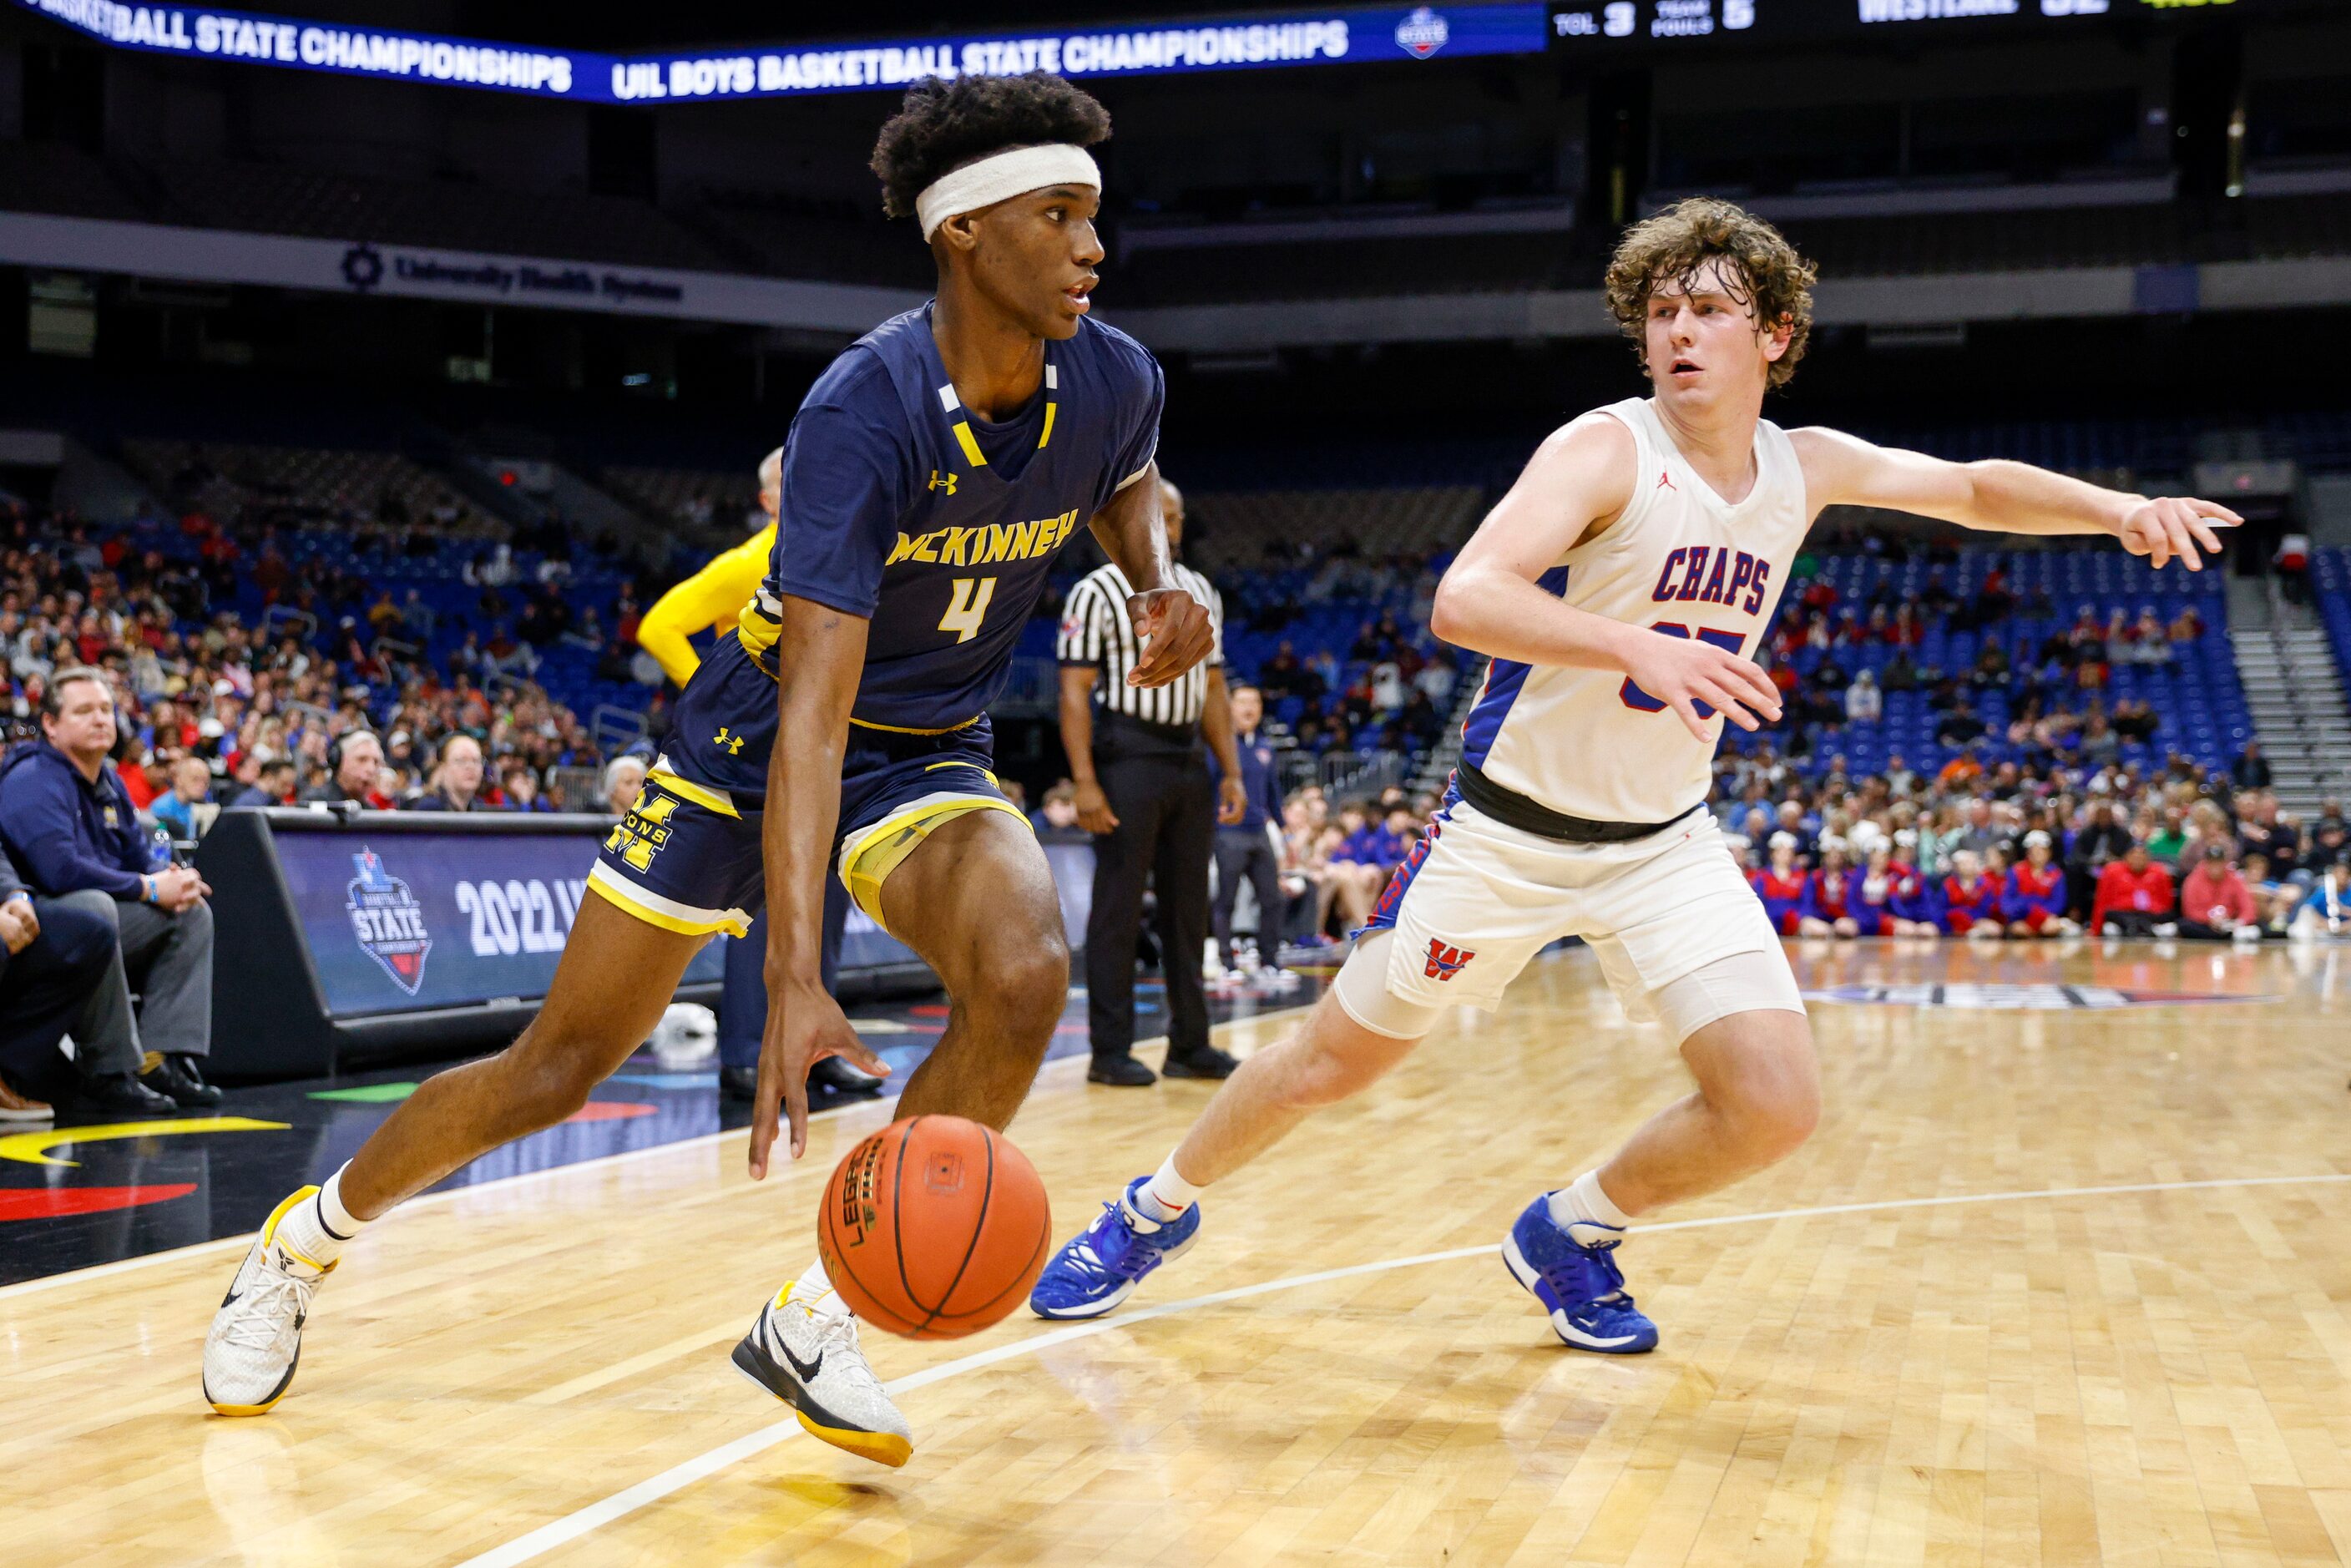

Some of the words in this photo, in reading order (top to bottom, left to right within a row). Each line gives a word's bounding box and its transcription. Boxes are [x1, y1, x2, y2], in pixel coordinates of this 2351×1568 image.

[1603, 1, 1637, 37] 3
[195, 14, 297, 61] STATE
[300, 28, 572, 93] CHAMPIONSHIPS
[611, 63, 667, 100] UIL
[669, 57, 756, 97] BOYS
[758, 43, 960, 92] BASKETBALL
[961, 38, 1062, 77] STATE
[1063, 19, 1349, 73] CHAMPIONSHIPS
[396, 255, 513, 293] University
[520, 264, 594, 294] Health
[601, 272, 684, 302] System
[885, 508, 1079, 567] MCKINNEY
[1651, 546, 1771, 616] CHAPS
[938, 577, 997, 645] 4
[623, 811, 667, 844] ONS
[351, 908, 428, 942] STATE
[455, 879, 566, 956] 2022
[1423, 936, 1476, 982] W
